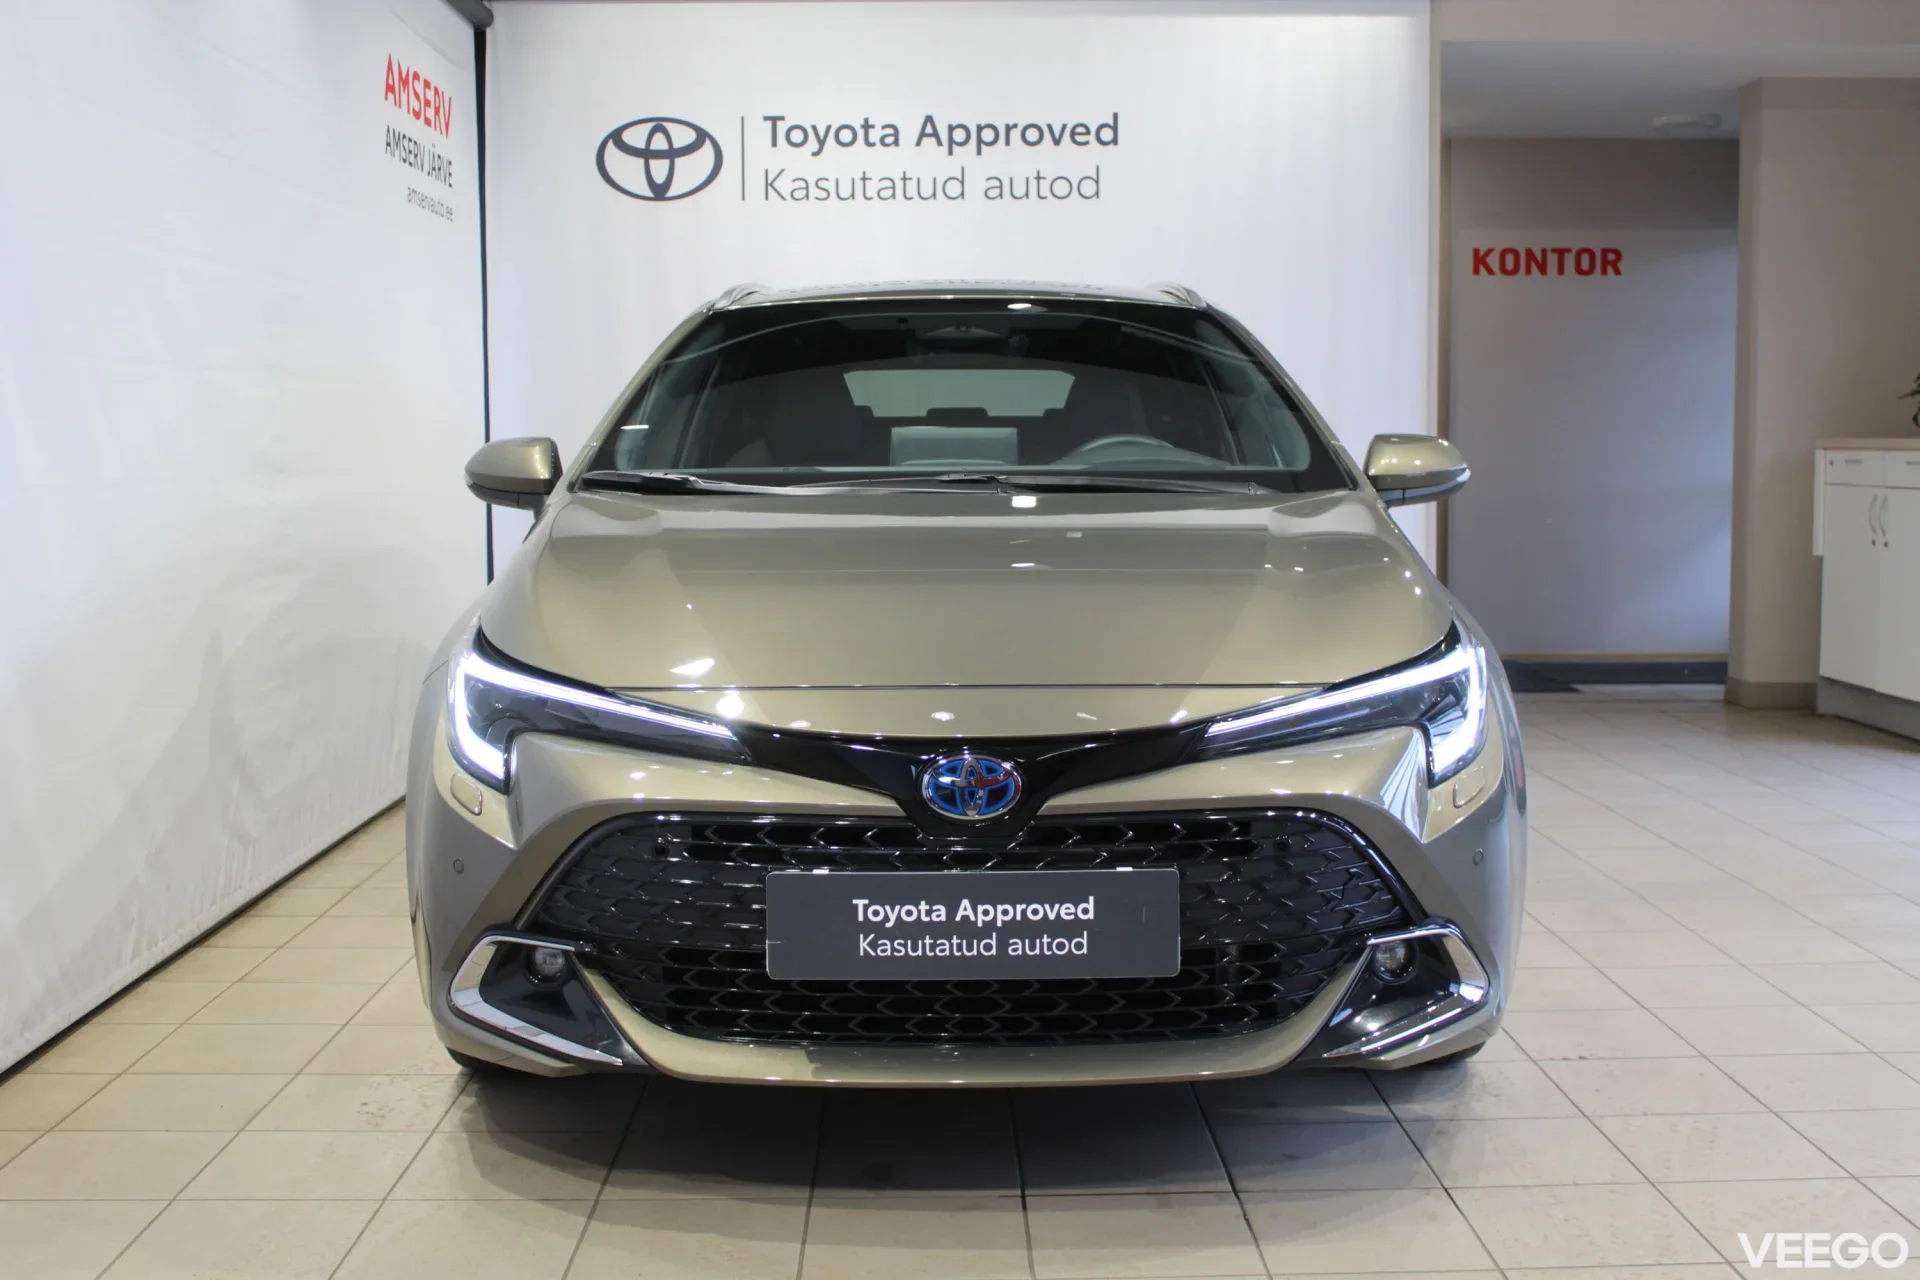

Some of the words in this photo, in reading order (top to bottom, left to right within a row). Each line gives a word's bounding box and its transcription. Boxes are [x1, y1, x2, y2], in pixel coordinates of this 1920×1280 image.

[384, 53, 452, 139] AMSERV
[763, 115, 900, 156] Toyota
[915, 112, 1119, 156] Approved
[385, 124, 426, 173] AMSERV
[427, 143, 453, 189] JÄRVE
[763, 166, 965, 201] Kasutatud
[983, 165, 1101, 200] autod
[407, 186, 454, 222] amservauto.ee
[1472, 247, 1623, 276] KONTOR
[852, 899, 946, 927] Toyota
[955, 896, 1095, 927] Approved
[859, 932, 997, 957] Kasutatud
[1007, 931, 1088, 955] autod
